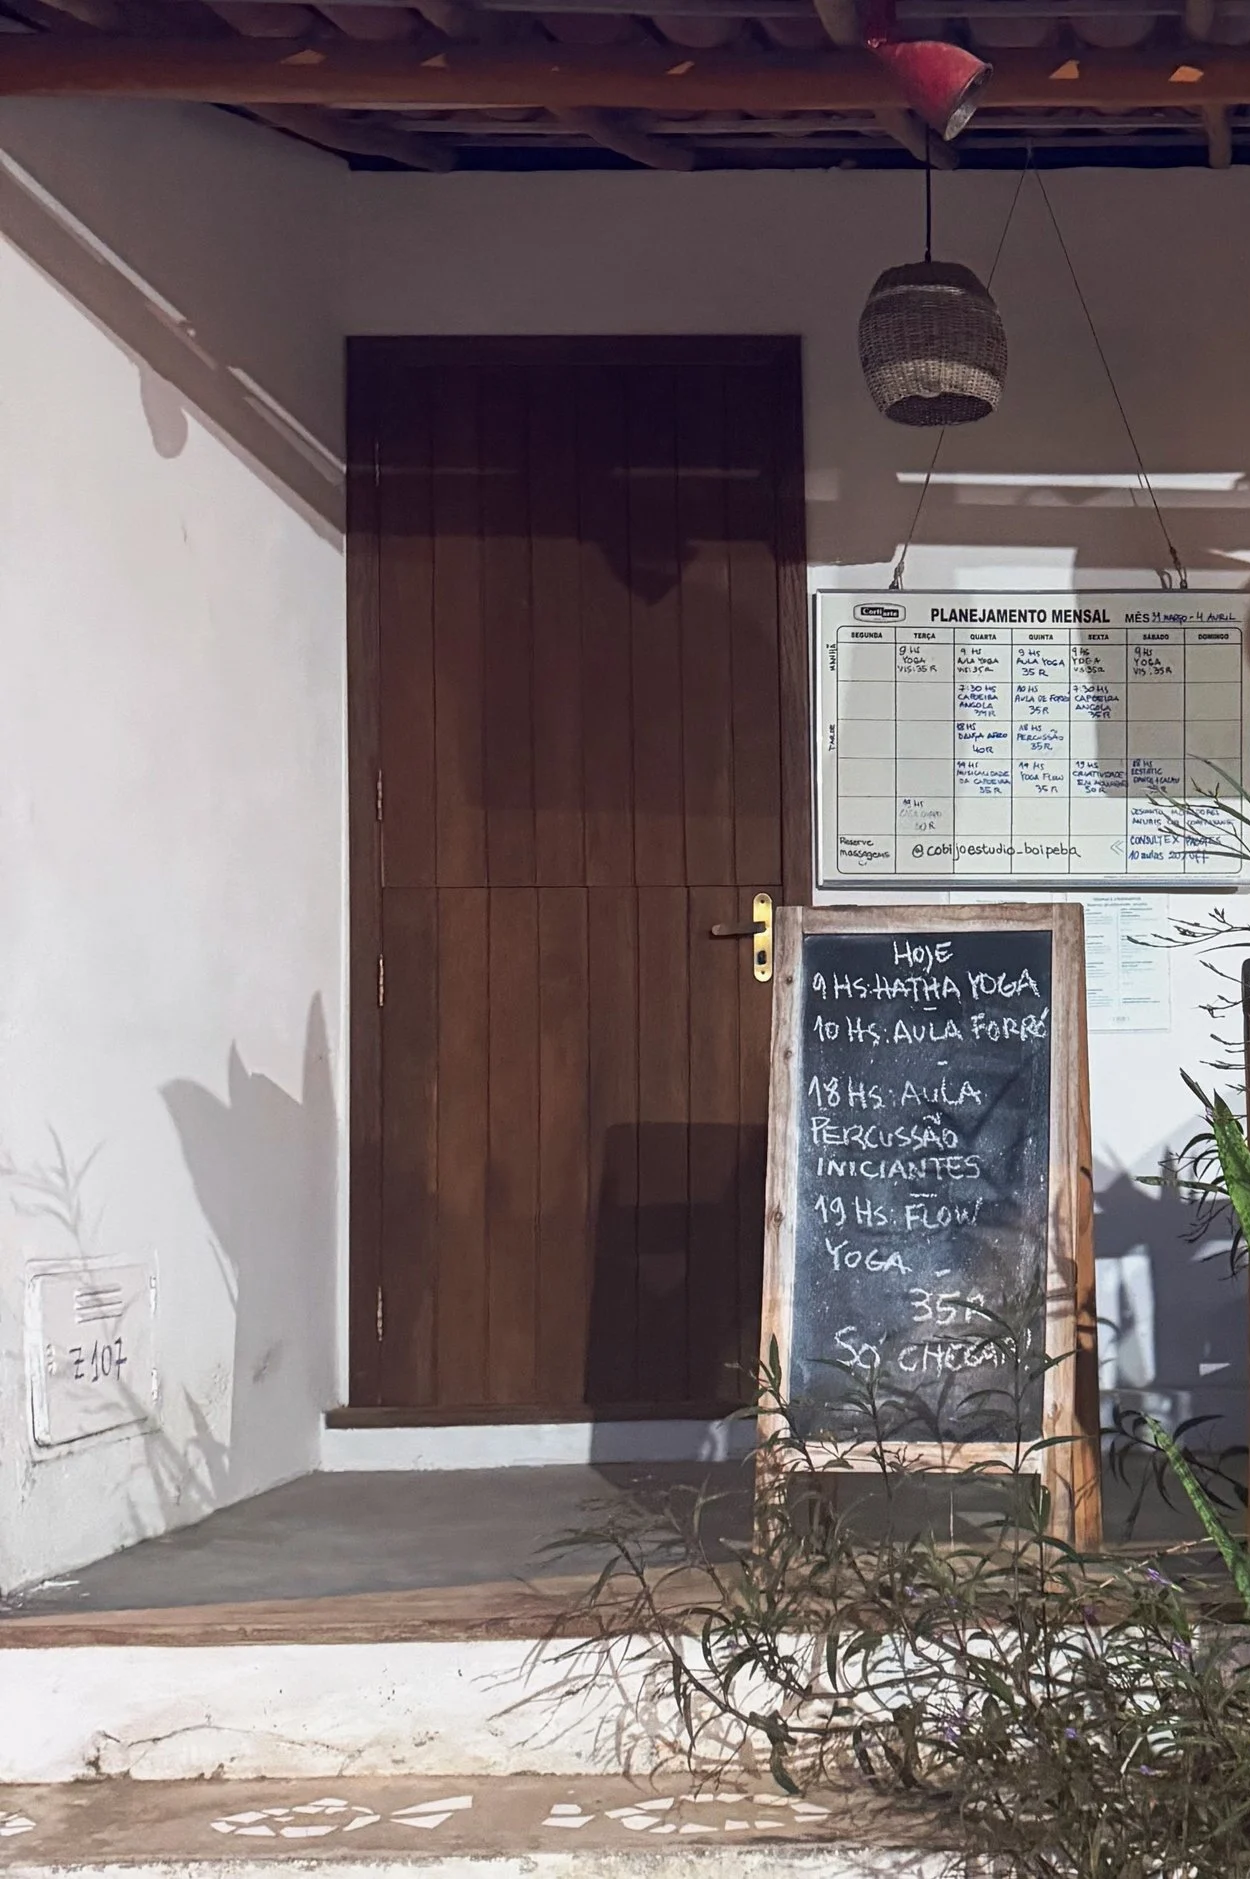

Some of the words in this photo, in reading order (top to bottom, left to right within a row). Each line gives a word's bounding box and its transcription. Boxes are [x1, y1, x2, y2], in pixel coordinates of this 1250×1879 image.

[931, 609, 1047, 623] PLANEJAMENTO
[1052, 609, 1110, 623] MENSAL
[1125, 611, 1150, 623] MÊS
[1143, 632, 1169, 640] SÁBADO
[903, 656, 926, 664] YOGA
[1041, 658, 1065, 666] YOGA
[1134, 658, 1161, 666] YOGA
[840, 837, 874, 846] Reserve
[893, 940, 954, 974] HOJE
[968, 968, 1042, 999] YOGA
[813, 1014, 840, 1043] 10
[893, 1017, 963, 1043] AULA
[808, 1077, 841, 1108] 18
[900, 1079, 983, 1108] AULA
[810, 1112, 958, 1151] PERCUSSÃO
[817, 1155, 983, 1180] INICIANTES
[814, 1196, 847, 1225] 19
[905, 1196, 983, 1232] FLOW
[825, 1239, 912, 1273] YOGA
